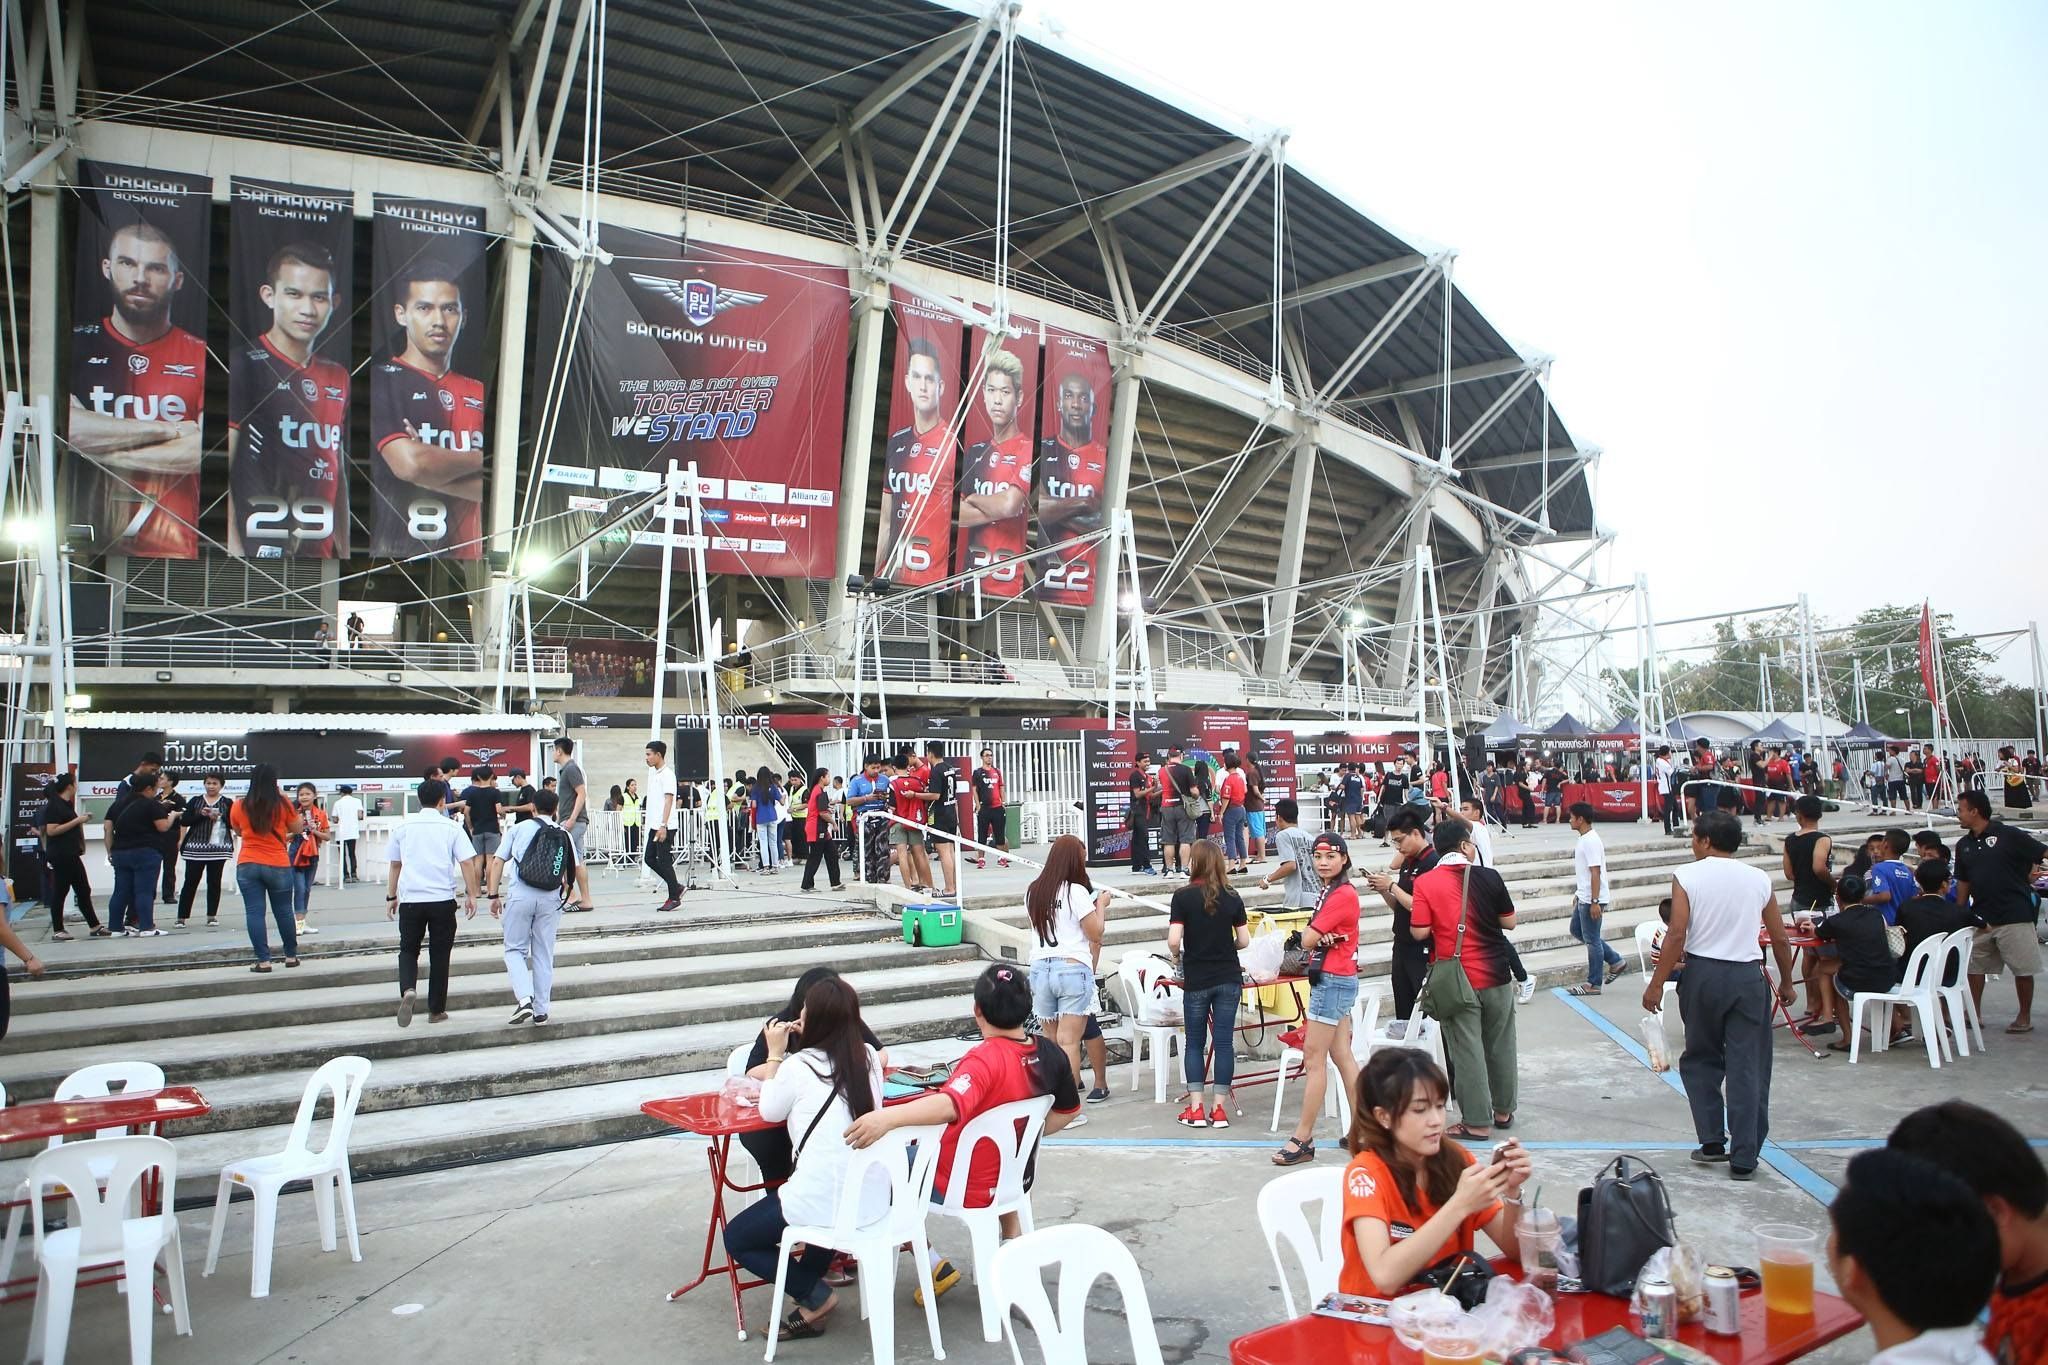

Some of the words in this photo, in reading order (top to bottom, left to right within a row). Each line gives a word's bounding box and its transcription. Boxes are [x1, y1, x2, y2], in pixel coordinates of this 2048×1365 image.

[112, 191, 180, 208] BOSKOVIC
[383, 204, 478, 227] WITTHAYA
[690, 292, 709, 304] BU
[689, 303, 709, 316] FC
[626, 320, 704, 345] BANGKOK
[709, 334, 768, 354] UNITED
[619, 379, 650, 392] THE
[653, 379, 687, 391] WAR
[689, 378, 704, 391] IS
[706, 377, 738, 390] NOT
[740, 375, 779, 388] OVER
[89, 385, 187, 422] true
[633, 388, 774, 417] TOGETHER
[279, 415, 341, 451] true
[611, 415, 651, 437] WE
[648, 410, 757, 443] STAND
[556, 469, 590, 480] DAIKIN
[888, 467, 933, 496] true
[791, 492, 819, 501] Allianz
[245, 495, 334, 540] 29
[407, 501, 448, 541] 8
[735, 513, 768, 523] Ziebart
[1044, 558, 1090, 591] 22
[1020, 717, 1051, 731] EXIT
[162, 739, 249, 762] ทีมเยือน
[1318, 743, 1353, 755] TEAM
[1354, 743, 1392, 754] TICKET
[186, 765, 219, 773] TEAM
[221, 764, 256, 773] TICKET
[1092, 761, 1133, 769] WELCOME
[92, 785, 118, 795] true
[553, 846, 564, 876] adidas
